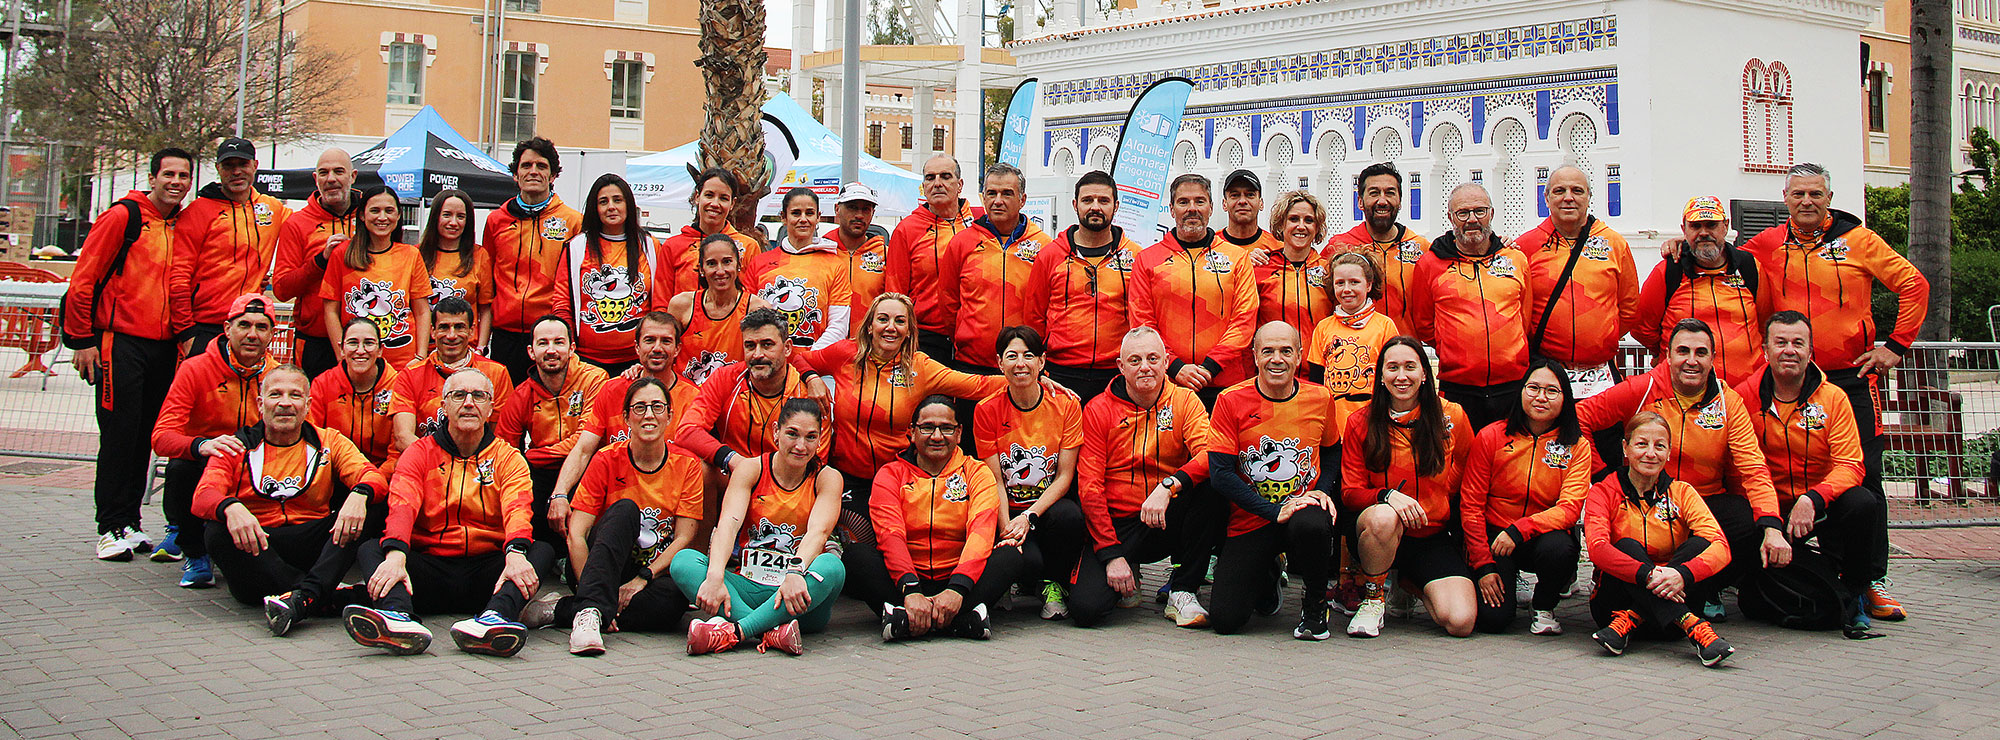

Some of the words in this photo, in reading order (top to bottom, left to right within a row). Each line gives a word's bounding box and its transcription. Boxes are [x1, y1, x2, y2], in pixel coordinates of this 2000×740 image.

[352, 146, 412, 161] POWER
[1124, 138, 1170, 158] Alquiler
[434, 146, 496, 169] POWER
[1121, 150, 1167, 171] Cámara
[257, 174, 284, 183] POWER
[386, 173, 415, 183] POWER
[429, 173, 459, 186] POWER
[1133, 177, 1162, 191] .com
[268, 183, 284, 192] ADE
[398, 182, 415, 191] ADE
[633, 184, 648, 192] 725
[649, 184, 665, 192] 392
[749, 551, 790, 570] 124
